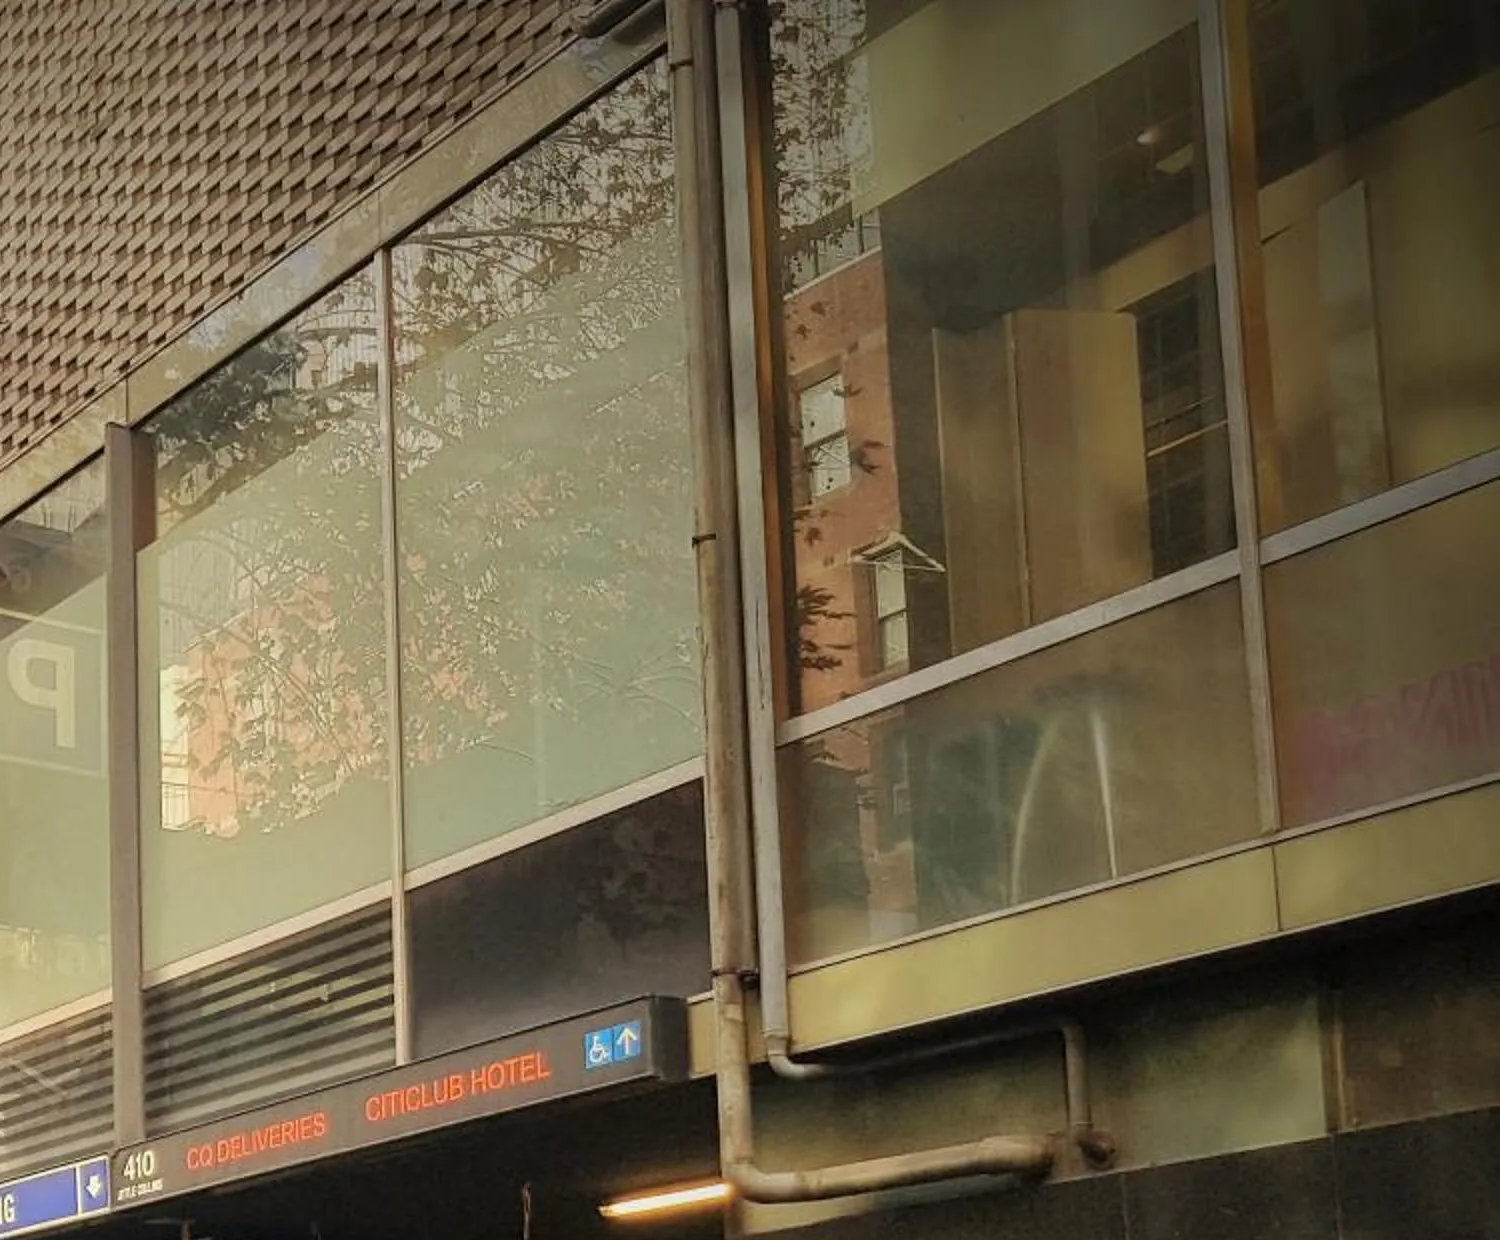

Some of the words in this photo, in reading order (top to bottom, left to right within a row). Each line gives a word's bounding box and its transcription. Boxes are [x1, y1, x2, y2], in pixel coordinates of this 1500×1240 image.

[365, 1073, 464, 1122] CITICLUB
[470, 1052, 551, 1096] HOTEL
[123, 1150, 156, 1181] 410
[187, 1144, 214, 1170] CQ
[216, 1112, 327, 1162] DELIVERIES
